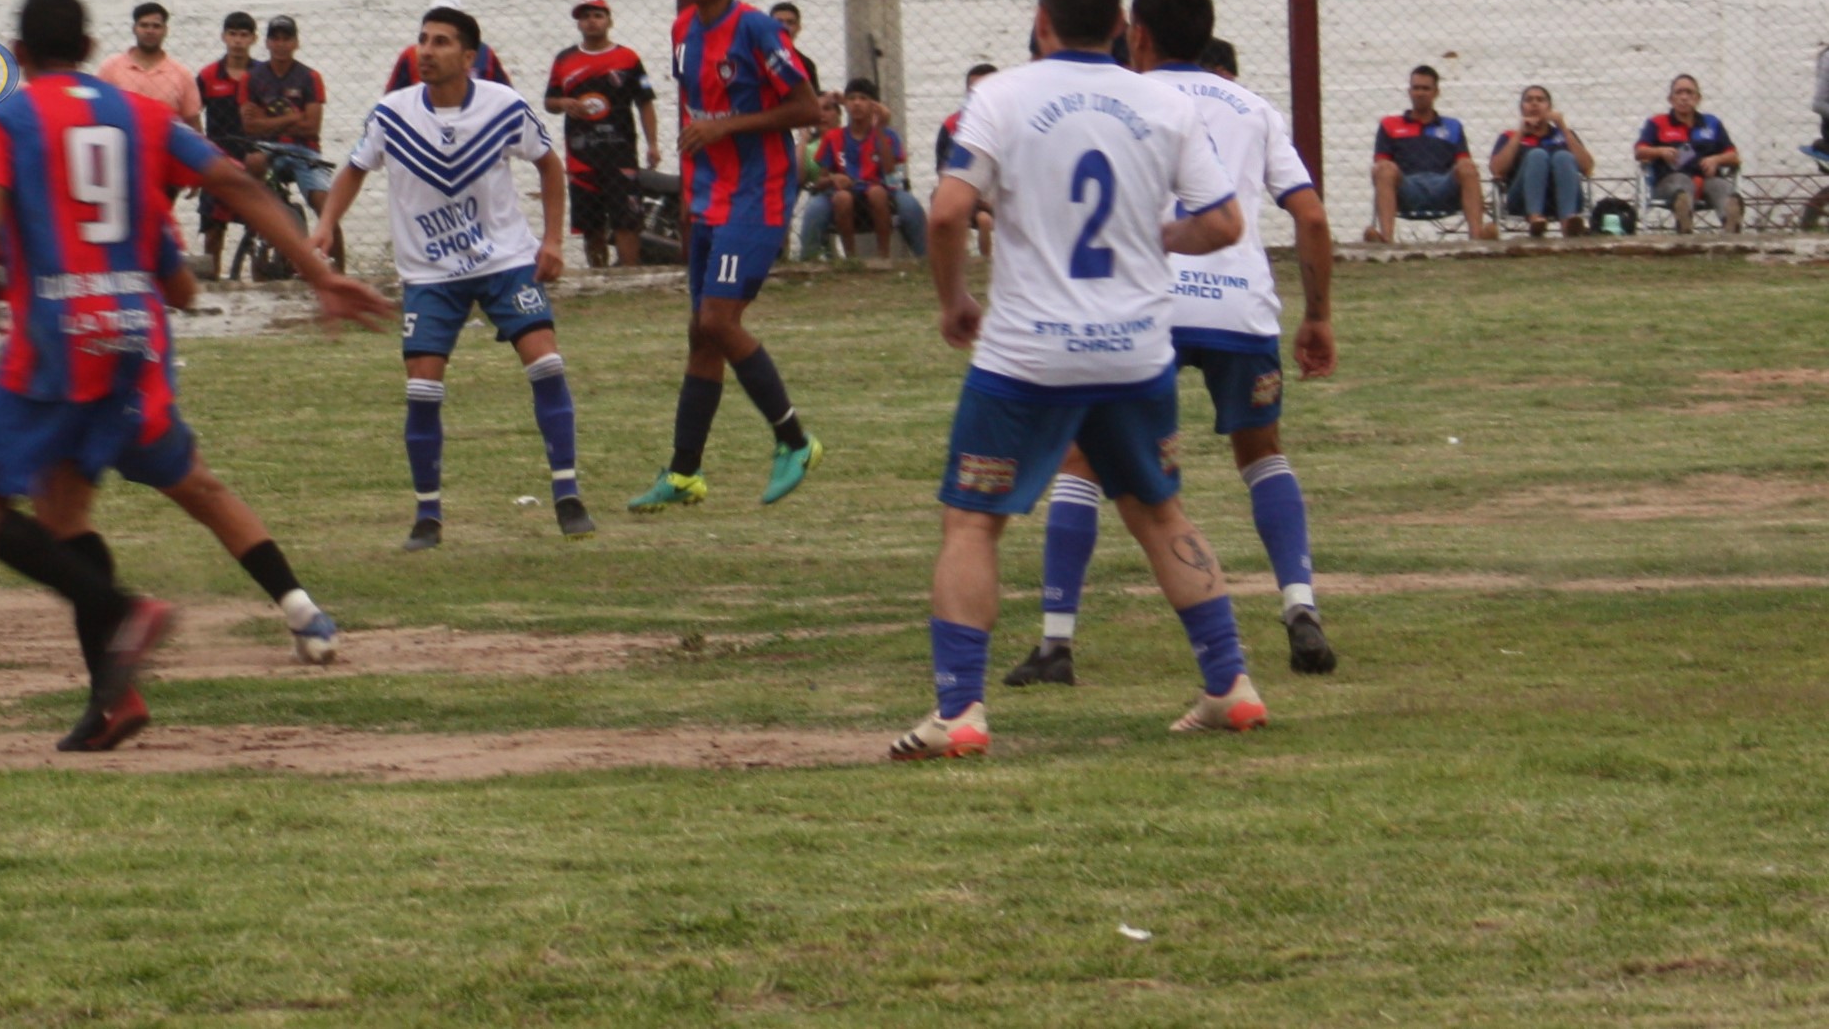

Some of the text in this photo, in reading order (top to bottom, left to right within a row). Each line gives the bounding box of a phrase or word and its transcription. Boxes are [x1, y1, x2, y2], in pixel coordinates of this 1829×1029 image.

[64, 125, 131, 243] 9
[1068, 148, 1117, 280] 2
[425, 221, 485, 263] SHOW
[716, 254, 739, 283] 11
[1180, 270, 1250, 290] SYLVINA
[1066, 338, 1134, 352] CHACO
